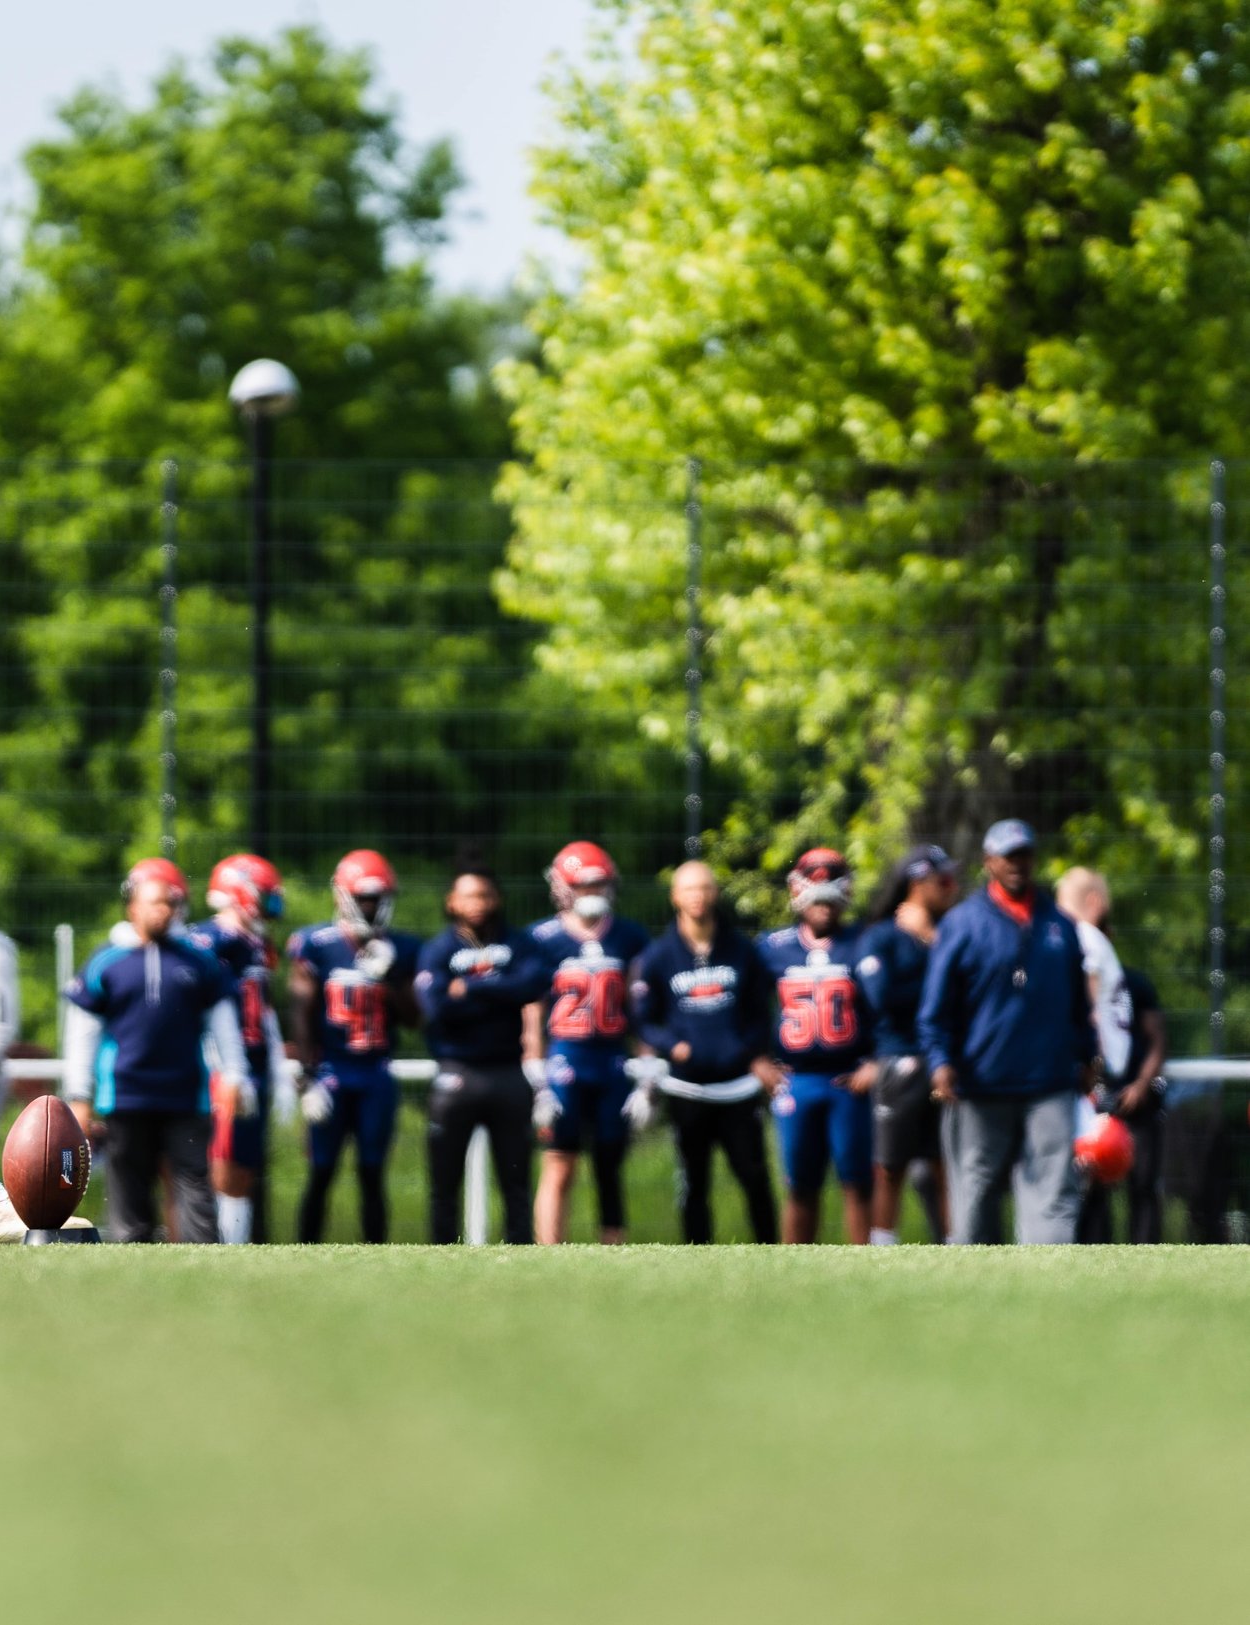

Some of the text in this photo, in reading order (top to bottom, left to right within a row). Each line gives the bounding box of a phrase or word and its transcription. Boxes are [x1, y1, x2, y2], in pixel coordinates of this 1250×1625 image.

[324, 980, 387, 1051] 41
[547, 968, 627, 1040] 20
[777, 977, 857, 1052] 50
[77, 1145, 86, 1190] Wilson
